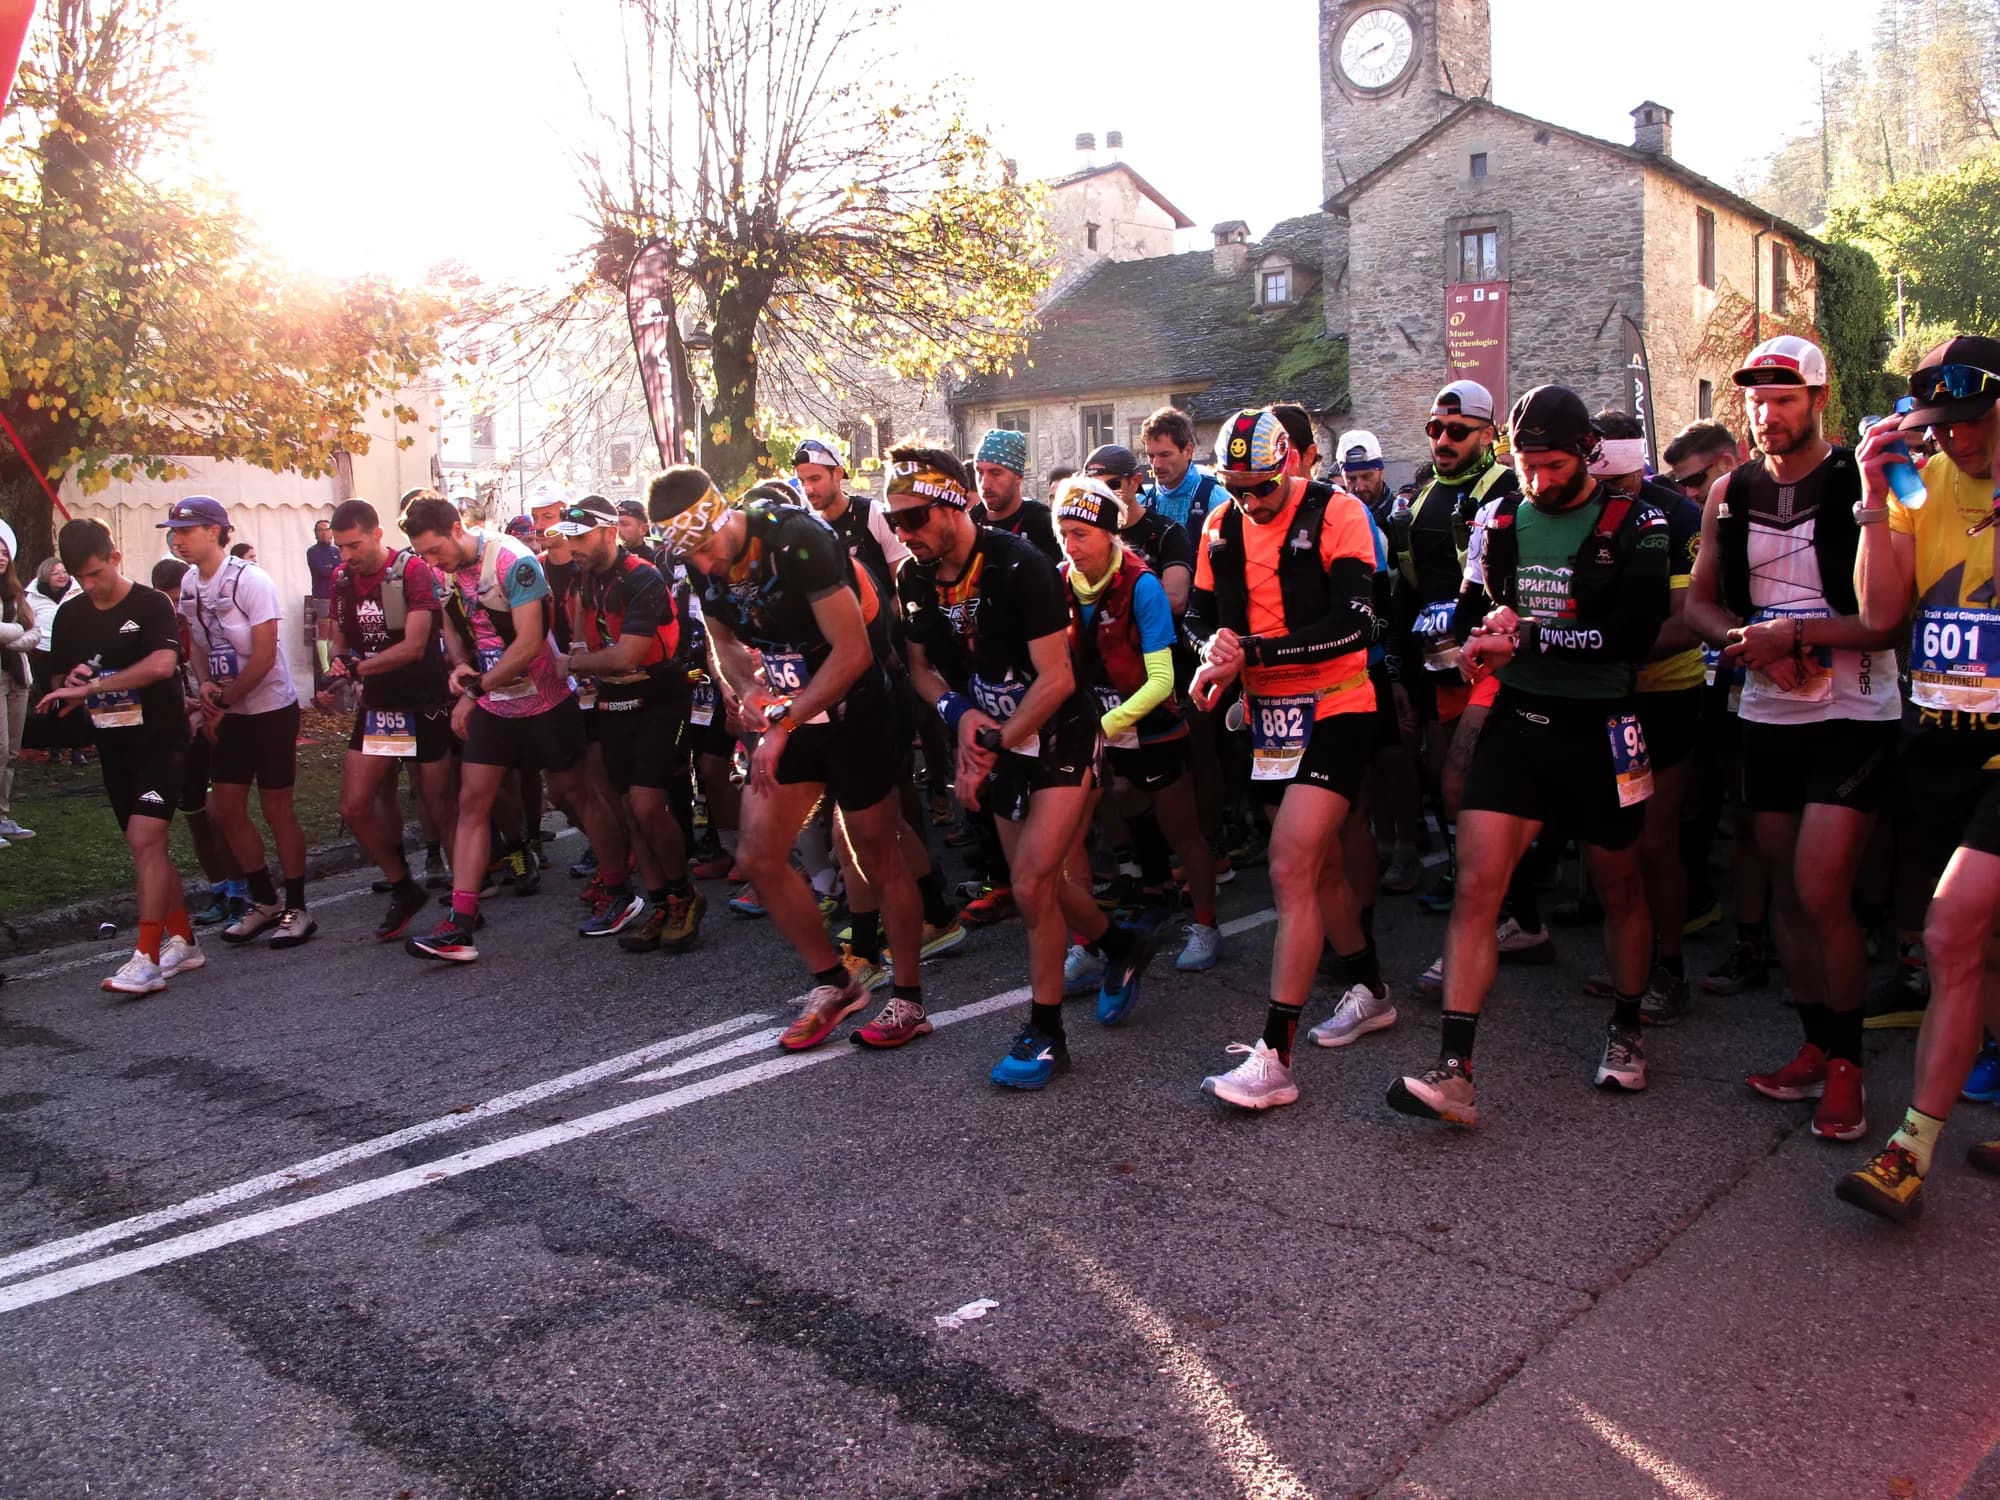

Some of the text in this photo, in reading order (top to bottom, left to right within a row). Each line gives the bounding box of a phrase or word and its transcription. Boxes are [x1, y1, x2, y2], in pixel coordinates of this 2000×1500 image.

[1449, 330, 1474, 338] Museo
[1449, 338, 1498, 348] Archeologico
[1073, 498, 1100, 514] YOUR
[1082, 492, 1102, 505] FOR
[1518, 578, 1568, 595] SPARTANI
[1923, 622, 1979, 660] 601
[974, 685, 1017, 717] 850
[376, 711, 405, 729] 965
[1261, 708, 1304, 738] 882
